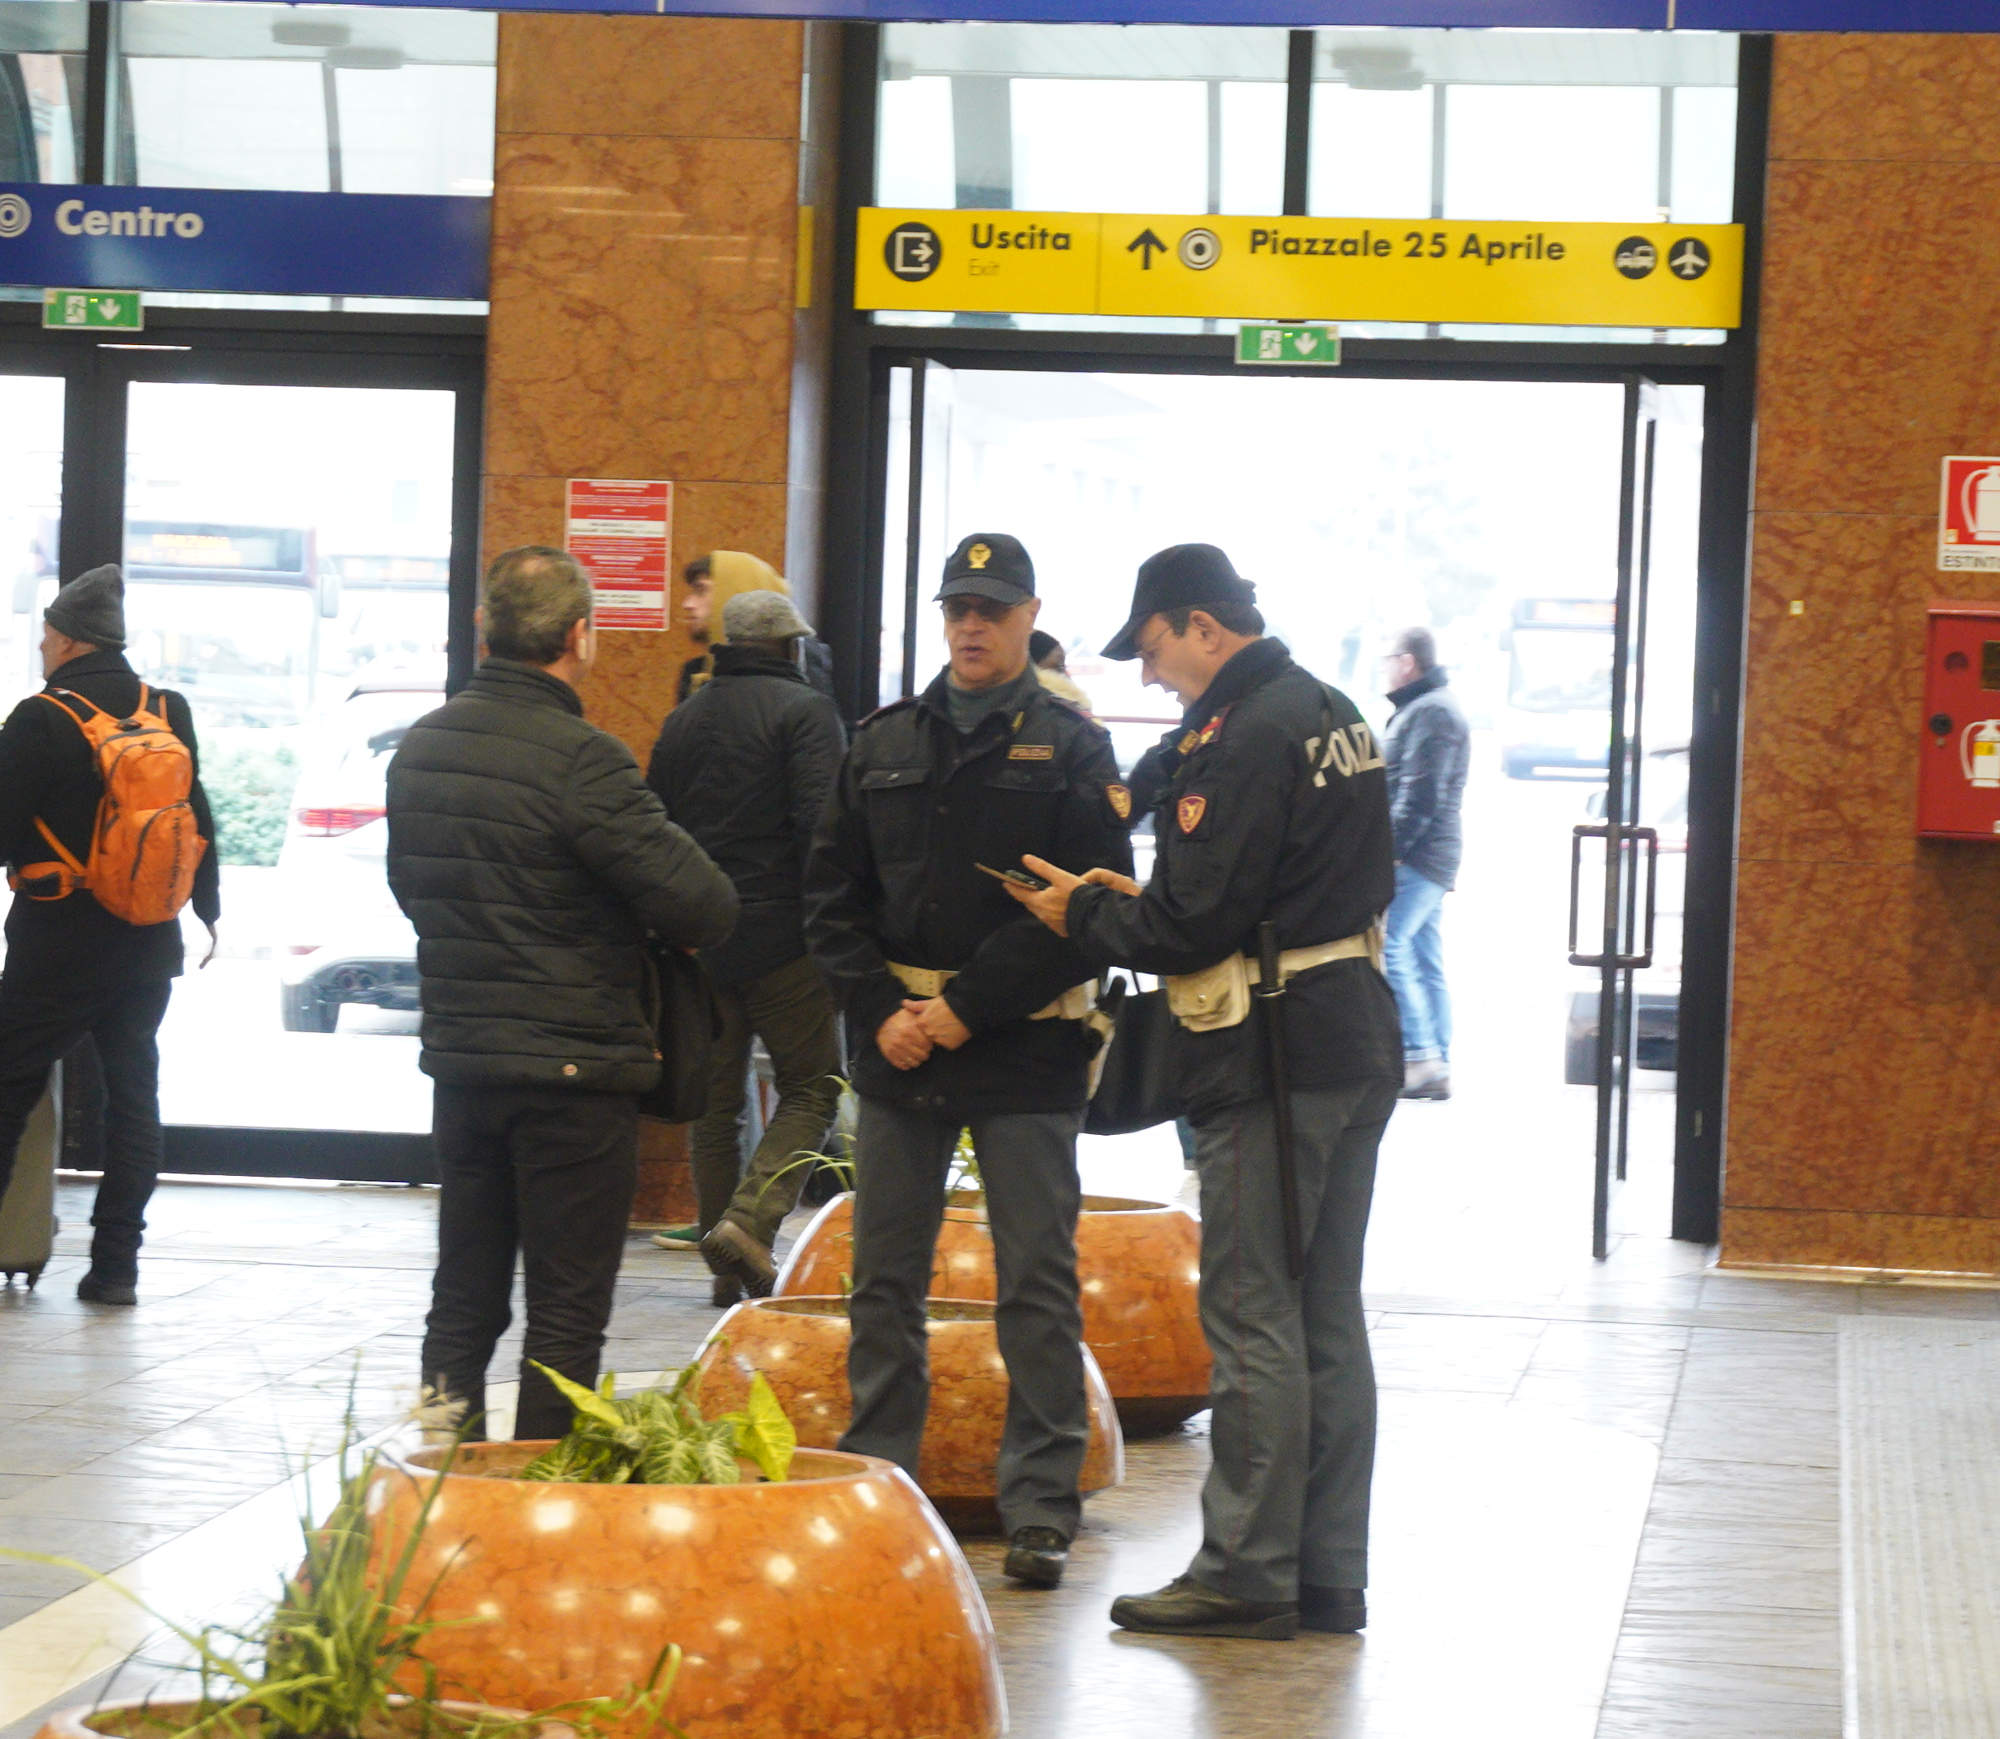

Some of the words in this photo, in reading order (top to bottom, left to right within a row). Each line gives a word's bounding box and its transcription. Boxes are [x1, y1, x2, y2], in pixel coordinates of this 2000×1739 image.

[54, 199, 204, 239] Centro
[971, 222, 1071, 251] Uscita
[1250, 229, 1392, 257] Piazzale
[1403, 232, 1448, 259] 25
[1459, 233, 1567, 266] Aprile
[969, 257, 1000, 277] Exit
